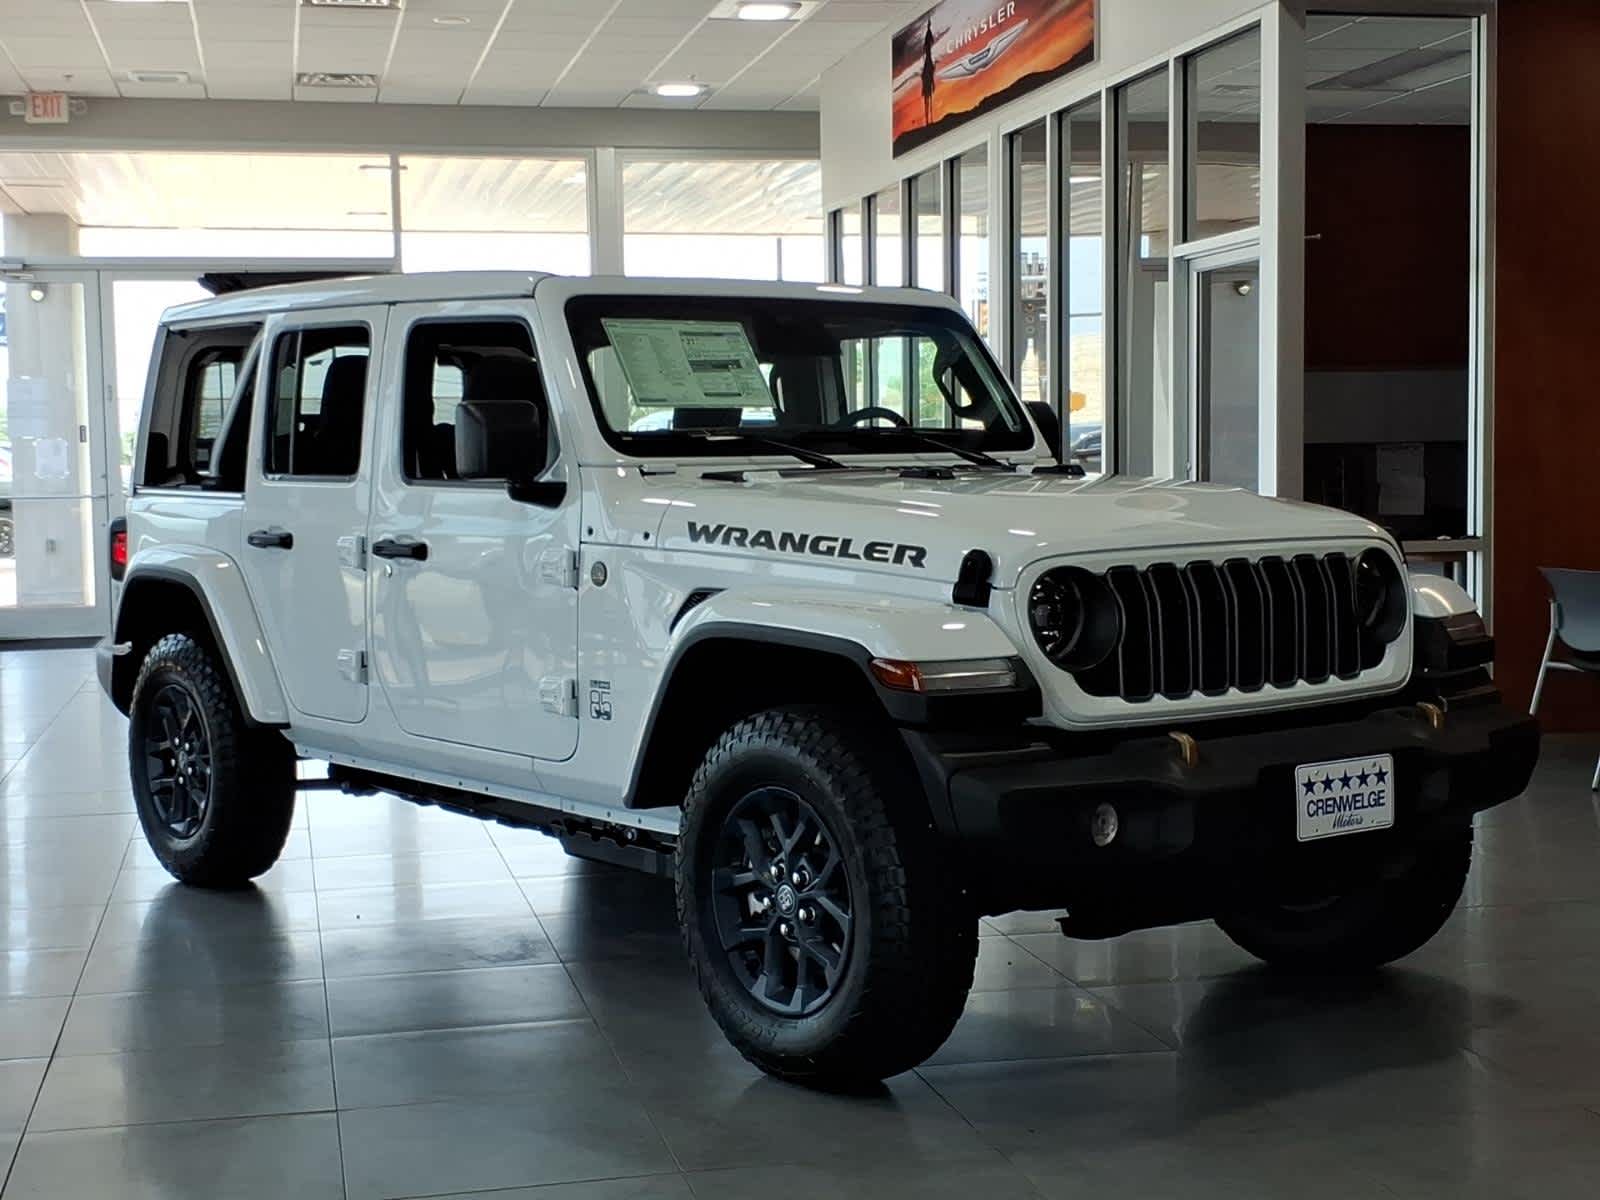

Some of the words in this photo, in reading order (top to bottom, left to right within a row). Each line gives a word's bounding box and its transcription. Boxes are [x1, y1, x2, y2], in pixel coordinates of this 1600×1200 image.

[946, 1, 1015, 53] CHRYSLER
[32, 95, 63, 117] EXIT
[687, 521, 927, 568] WRANGLER
[1306, 789, 1386, 818] CRENWELGE
[1332, 813, 1364, 829] Motors
